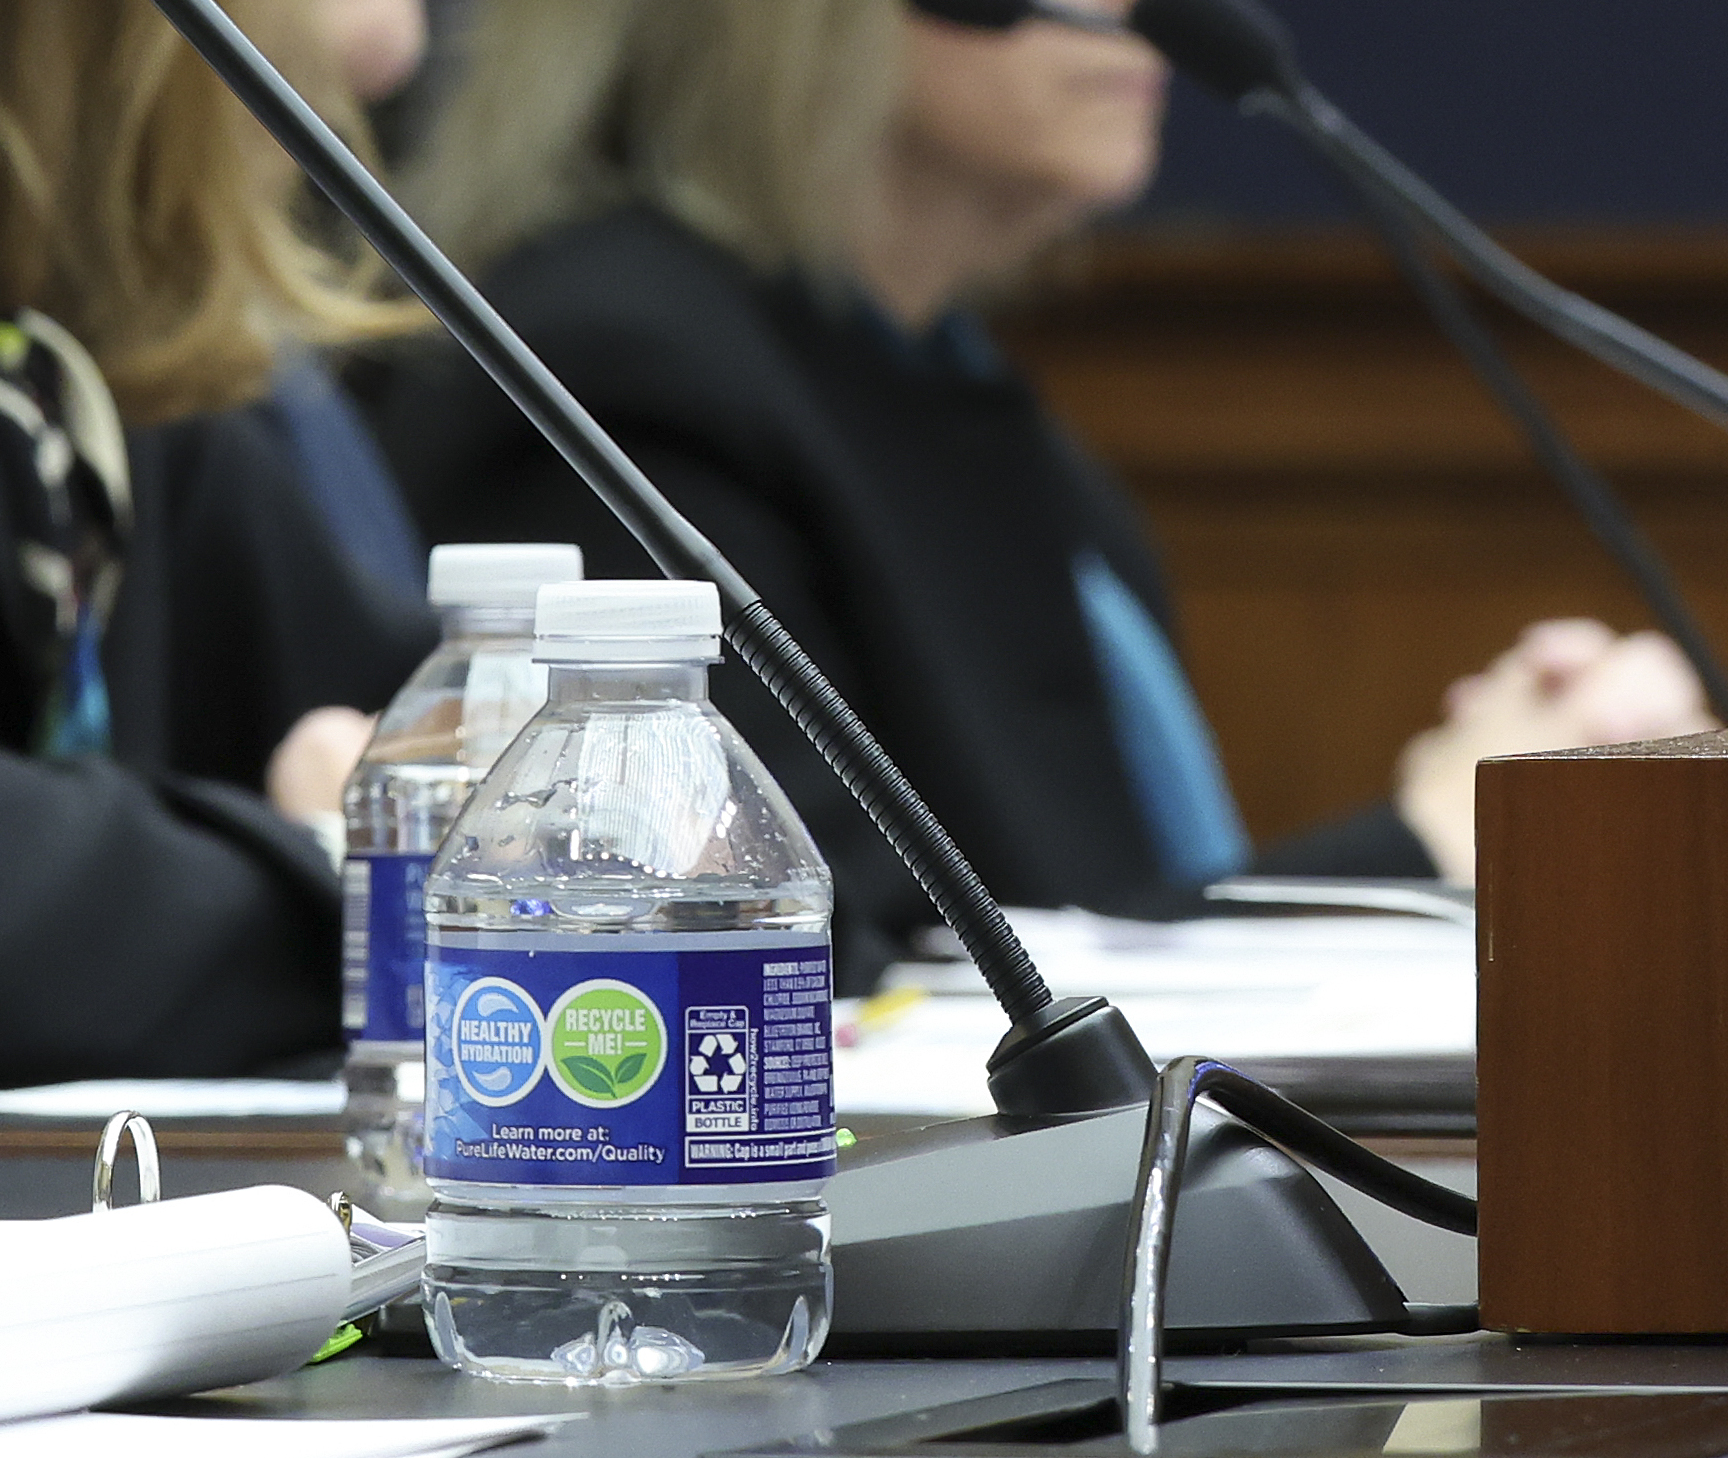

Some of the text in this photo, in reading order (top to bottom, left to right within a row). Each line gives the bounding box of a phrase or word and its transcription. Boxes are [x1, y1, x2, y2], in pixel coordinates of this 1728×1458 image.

[565, 1009, 646, 1032] RECYCLE
[728, 1019, 745, 1029] Cap
[461, 1020, 532, 1043] HEALTHY
[461, 1044, 533, 1064] HYDRATION
[587, 1033, 623, 1056] ME!
[692, 1100, 744, 1113] PLASTIC
[492, 1123, 610, 1141] Learn more at:
[695, 1116, 743, 1129] BOTTLE
[456, 1140, 665, 1164] PureLifeWater.com/Quality
[690, 1143, 733, 1159] WARNING:
